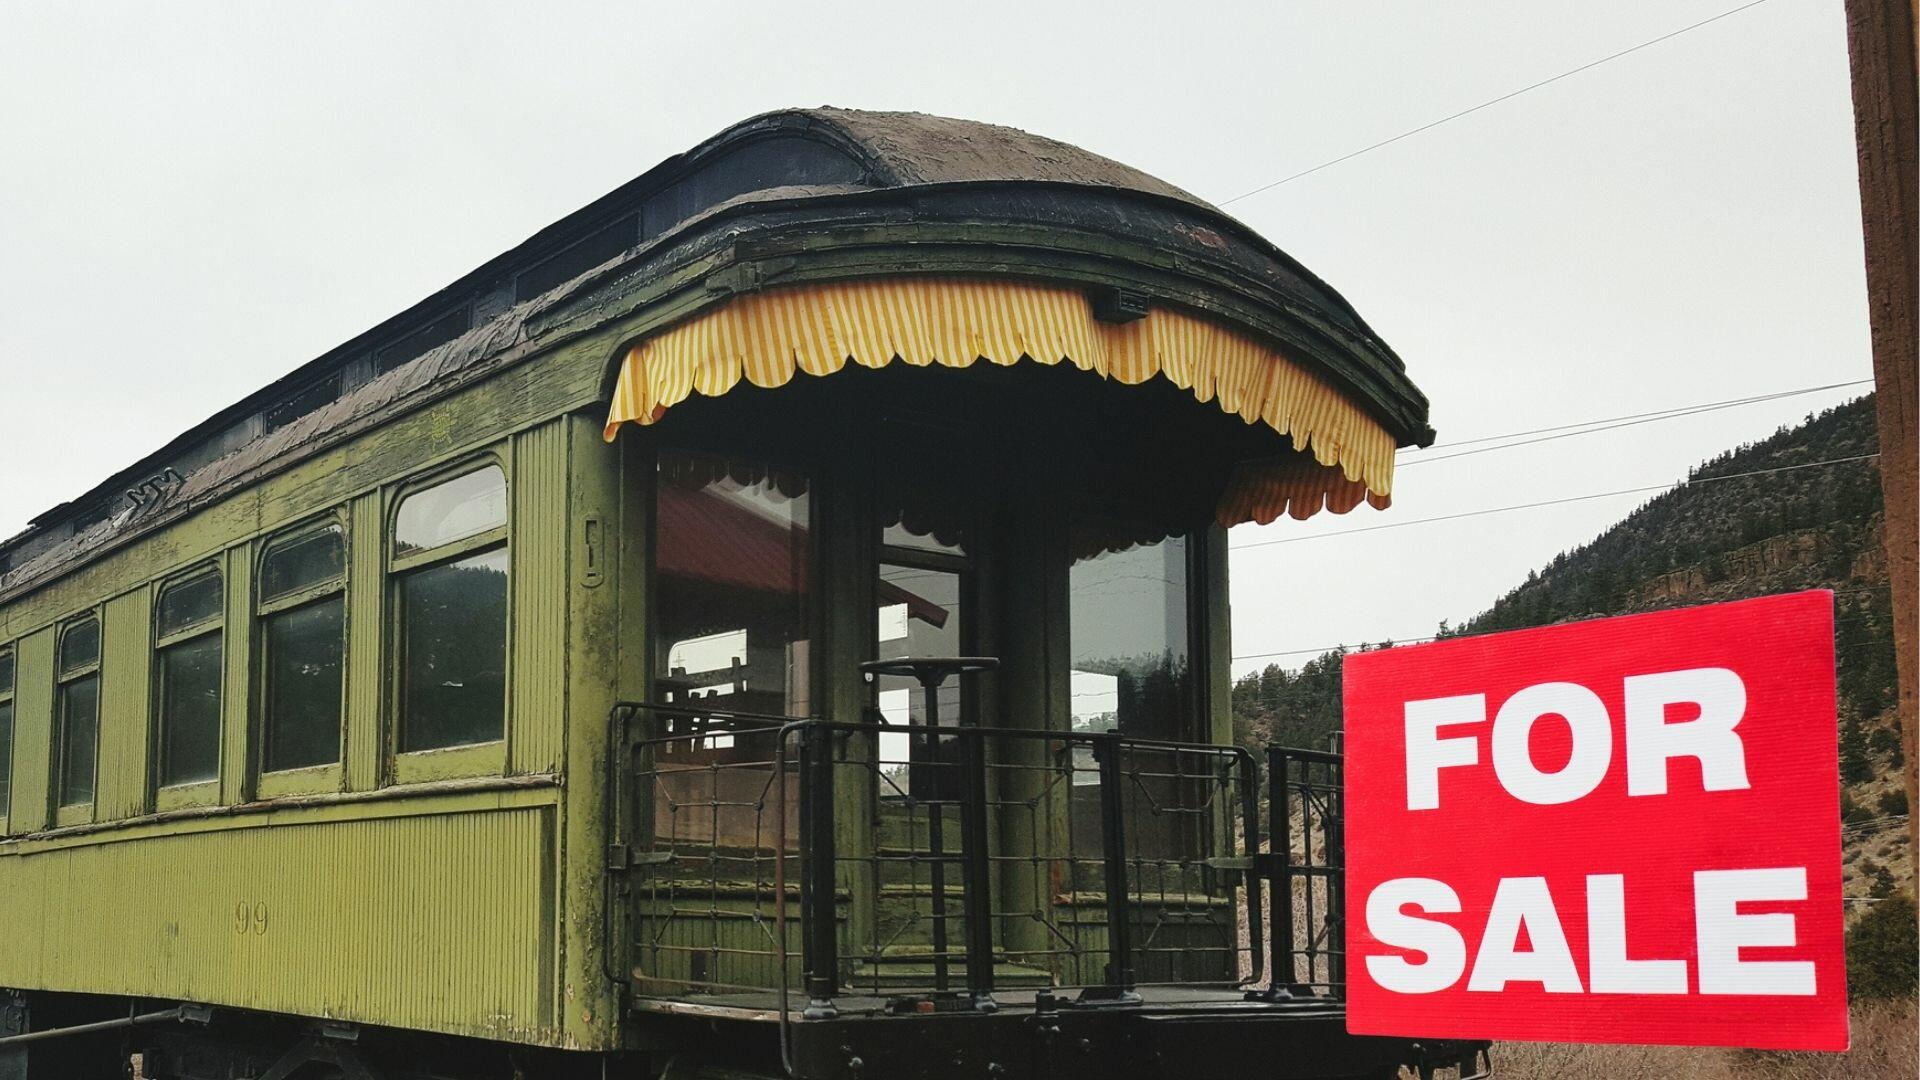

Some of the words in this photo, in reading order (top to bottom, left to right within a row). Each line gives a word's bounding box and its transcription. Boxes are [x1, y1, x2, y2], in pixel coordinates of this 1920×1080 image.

[1404, 667, 1751, 811] FOR
[235, 901, 268, 936] 99
[1365, 867, 1817, 996] SALE
